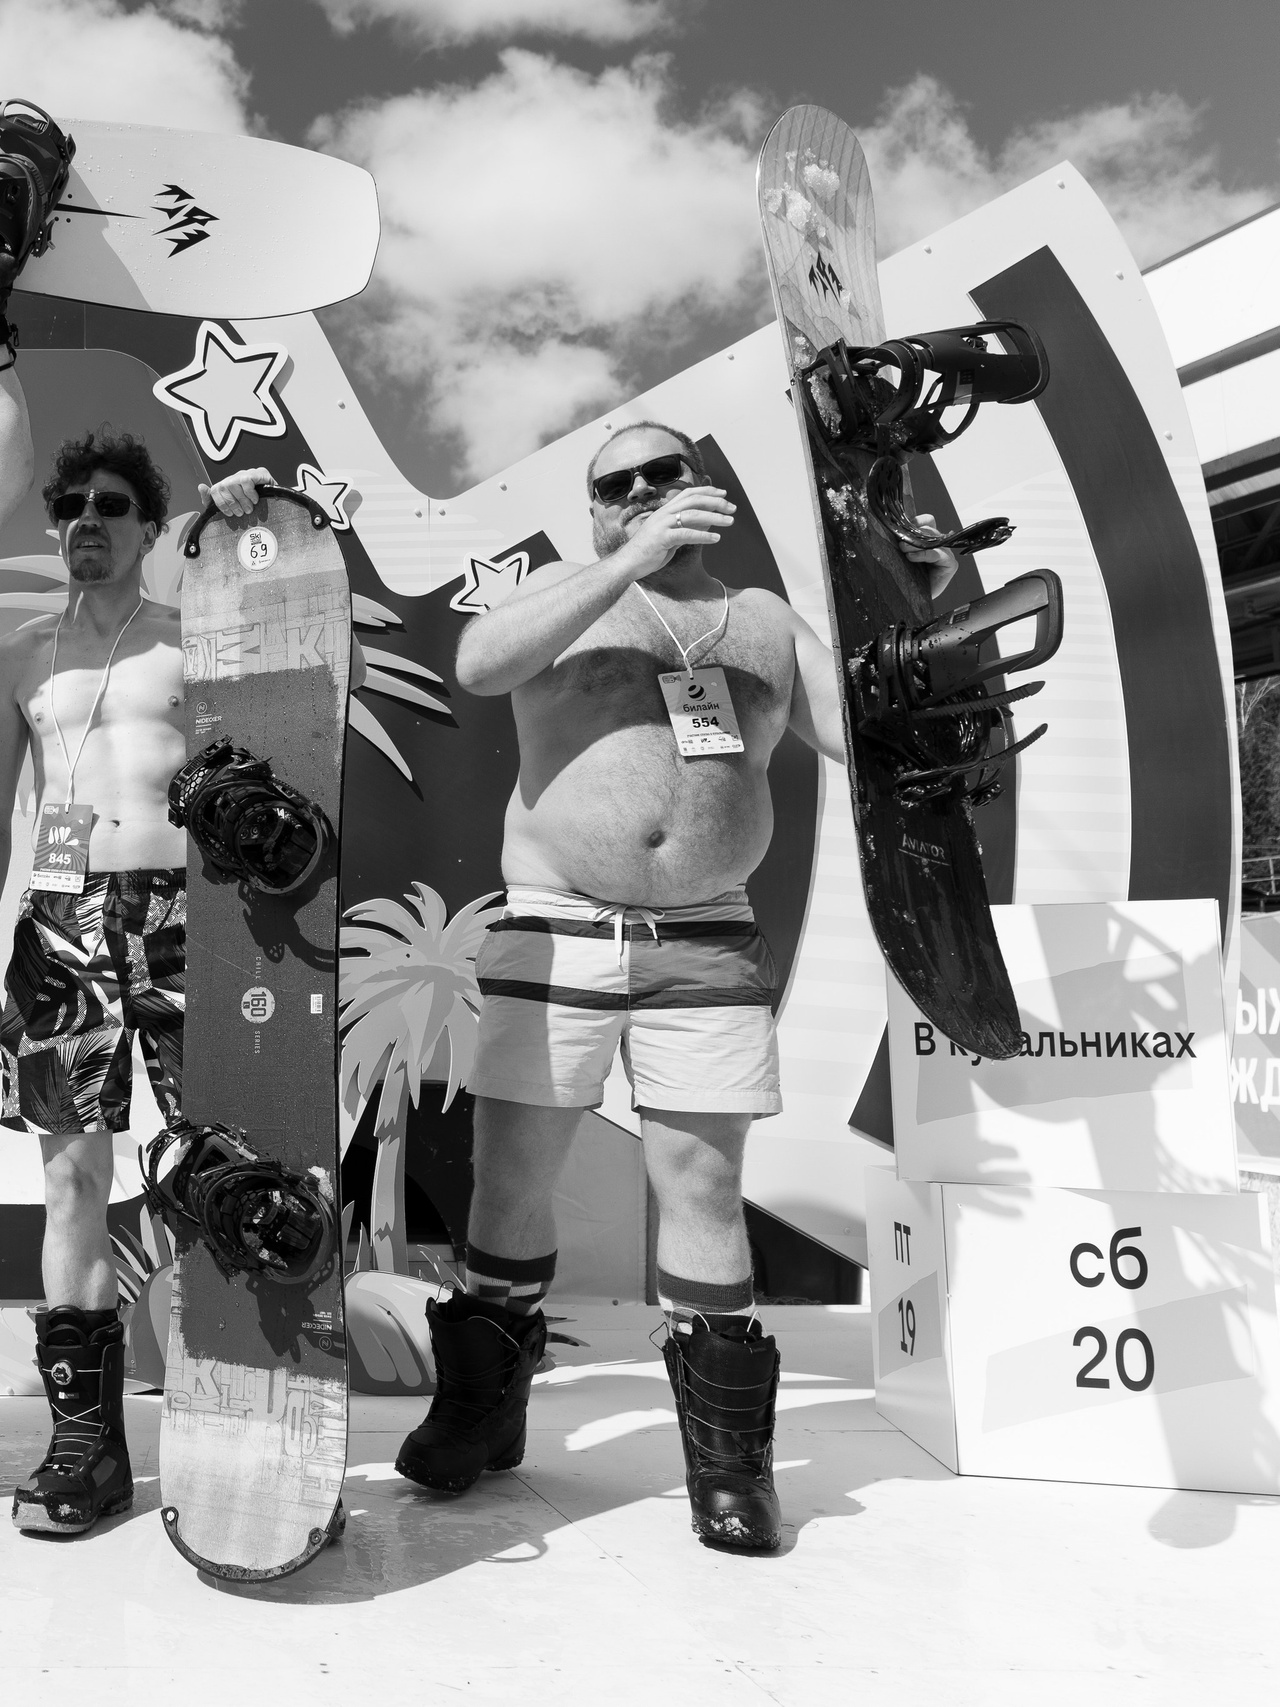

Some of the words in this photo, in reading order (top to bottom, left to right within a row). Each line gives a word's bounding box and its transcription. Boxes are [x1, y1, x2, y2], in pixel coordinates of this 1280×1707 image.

[250, 543, 268, 559] 69
[682, 701, 720, 713] билайн
[692, 716, 720, 729] 554
[48, 852, 72, 865] 845
[902, 833, 946, 860] AVIATOR
[250, 991, 267, 1018] 160
[914, 1022, 936, 1056] В
[1069, 1226, 1149, 1290] сб
[897, 1297, 916, 1357] 19
[1072, 1325, 1155, 1392] 20
